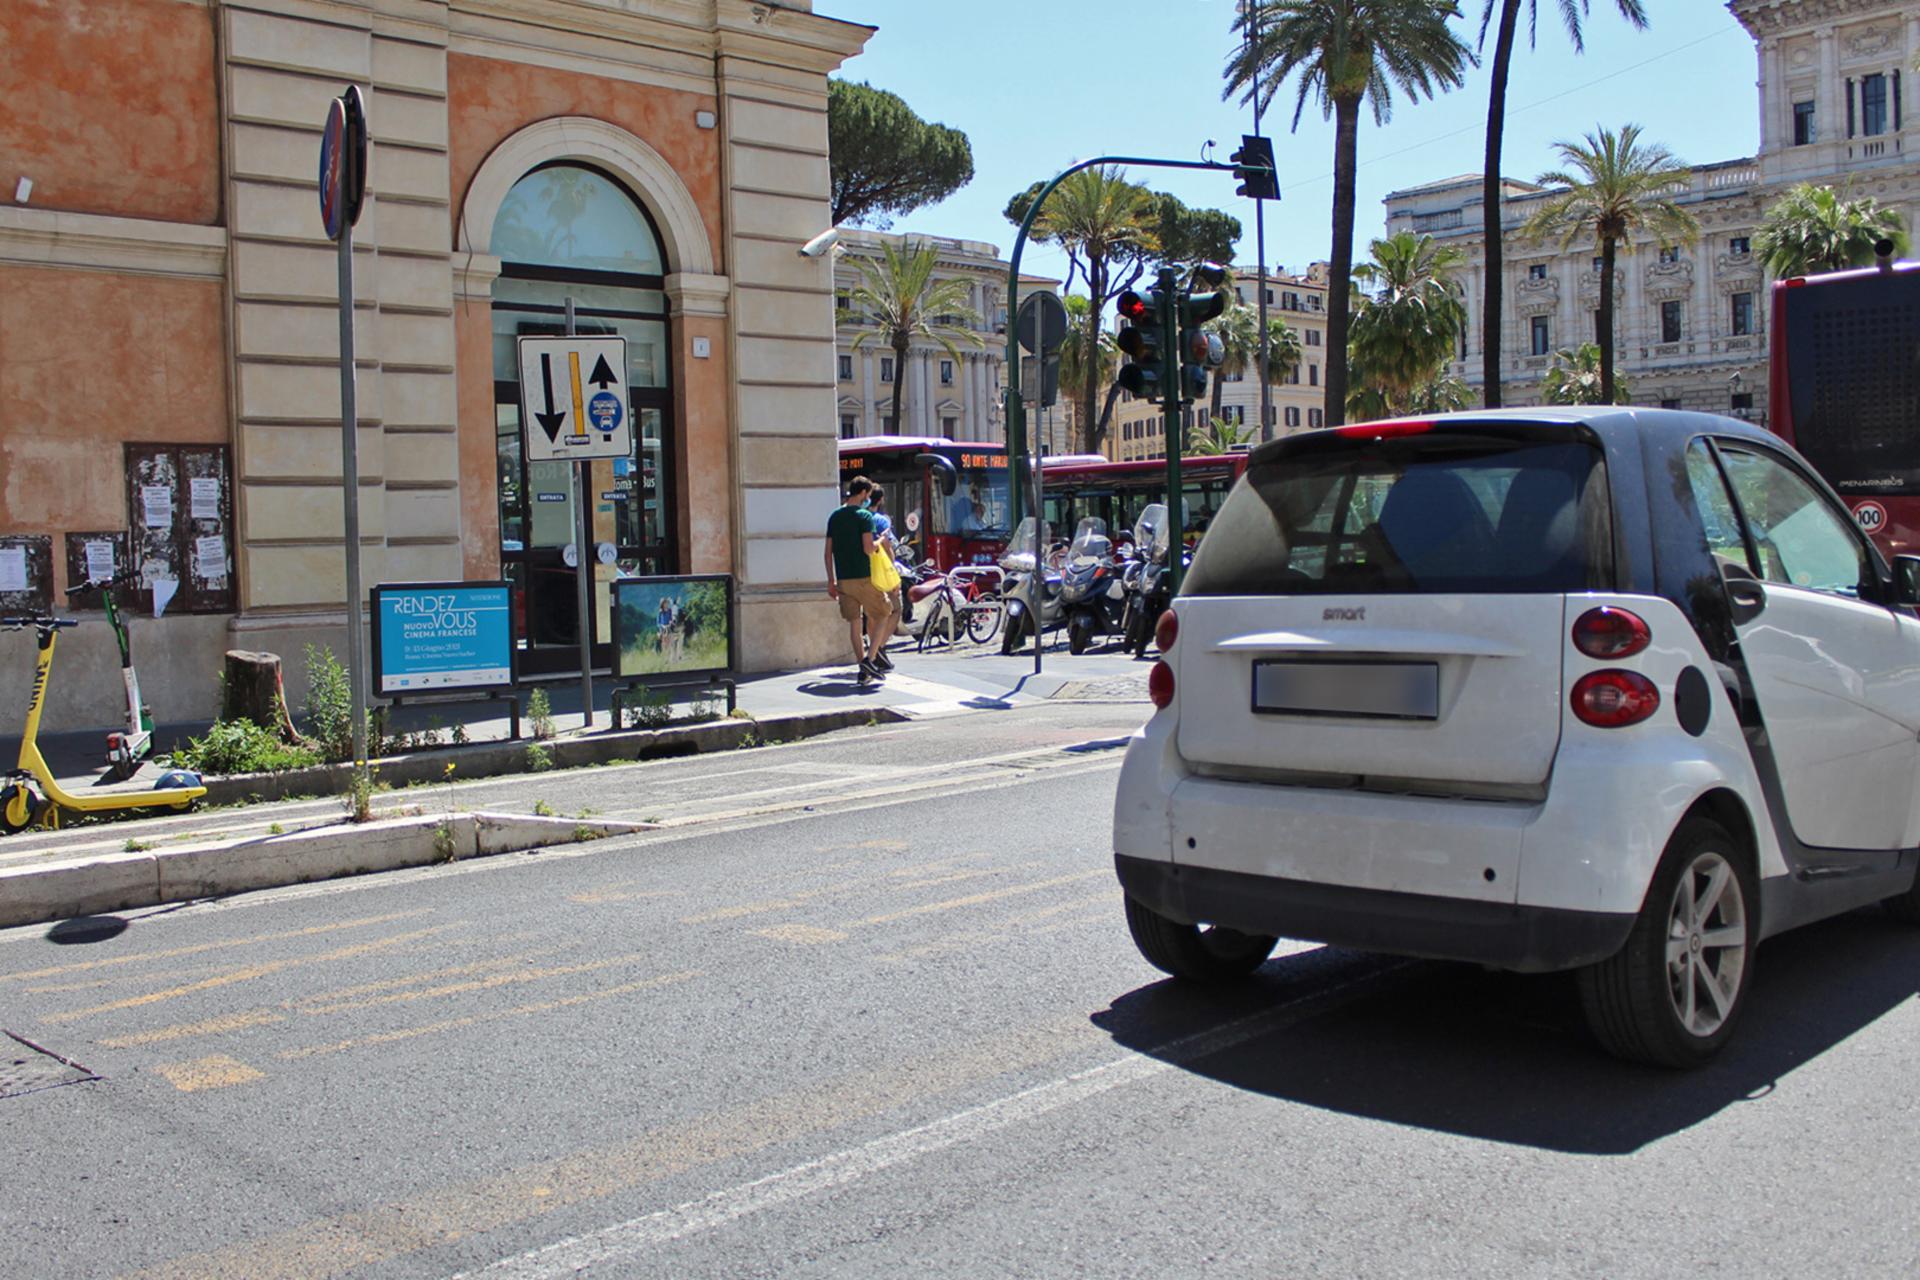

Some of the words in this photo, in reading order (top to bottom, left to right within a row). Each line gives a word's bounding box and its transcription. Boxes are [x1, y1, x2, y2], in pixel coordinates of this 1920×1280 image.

[1858, 510, 1881, 525] 100
[394, 596, 456, 613] RENDEZ
[431, 611, 477, 629] VOUS
[1323, 607, 1365, 620] smart
[403, 622, 434, 631] NUOVO
[403, 631, 435, 639] CINEMA
[438, 628, 477, 637] FRANCESE
